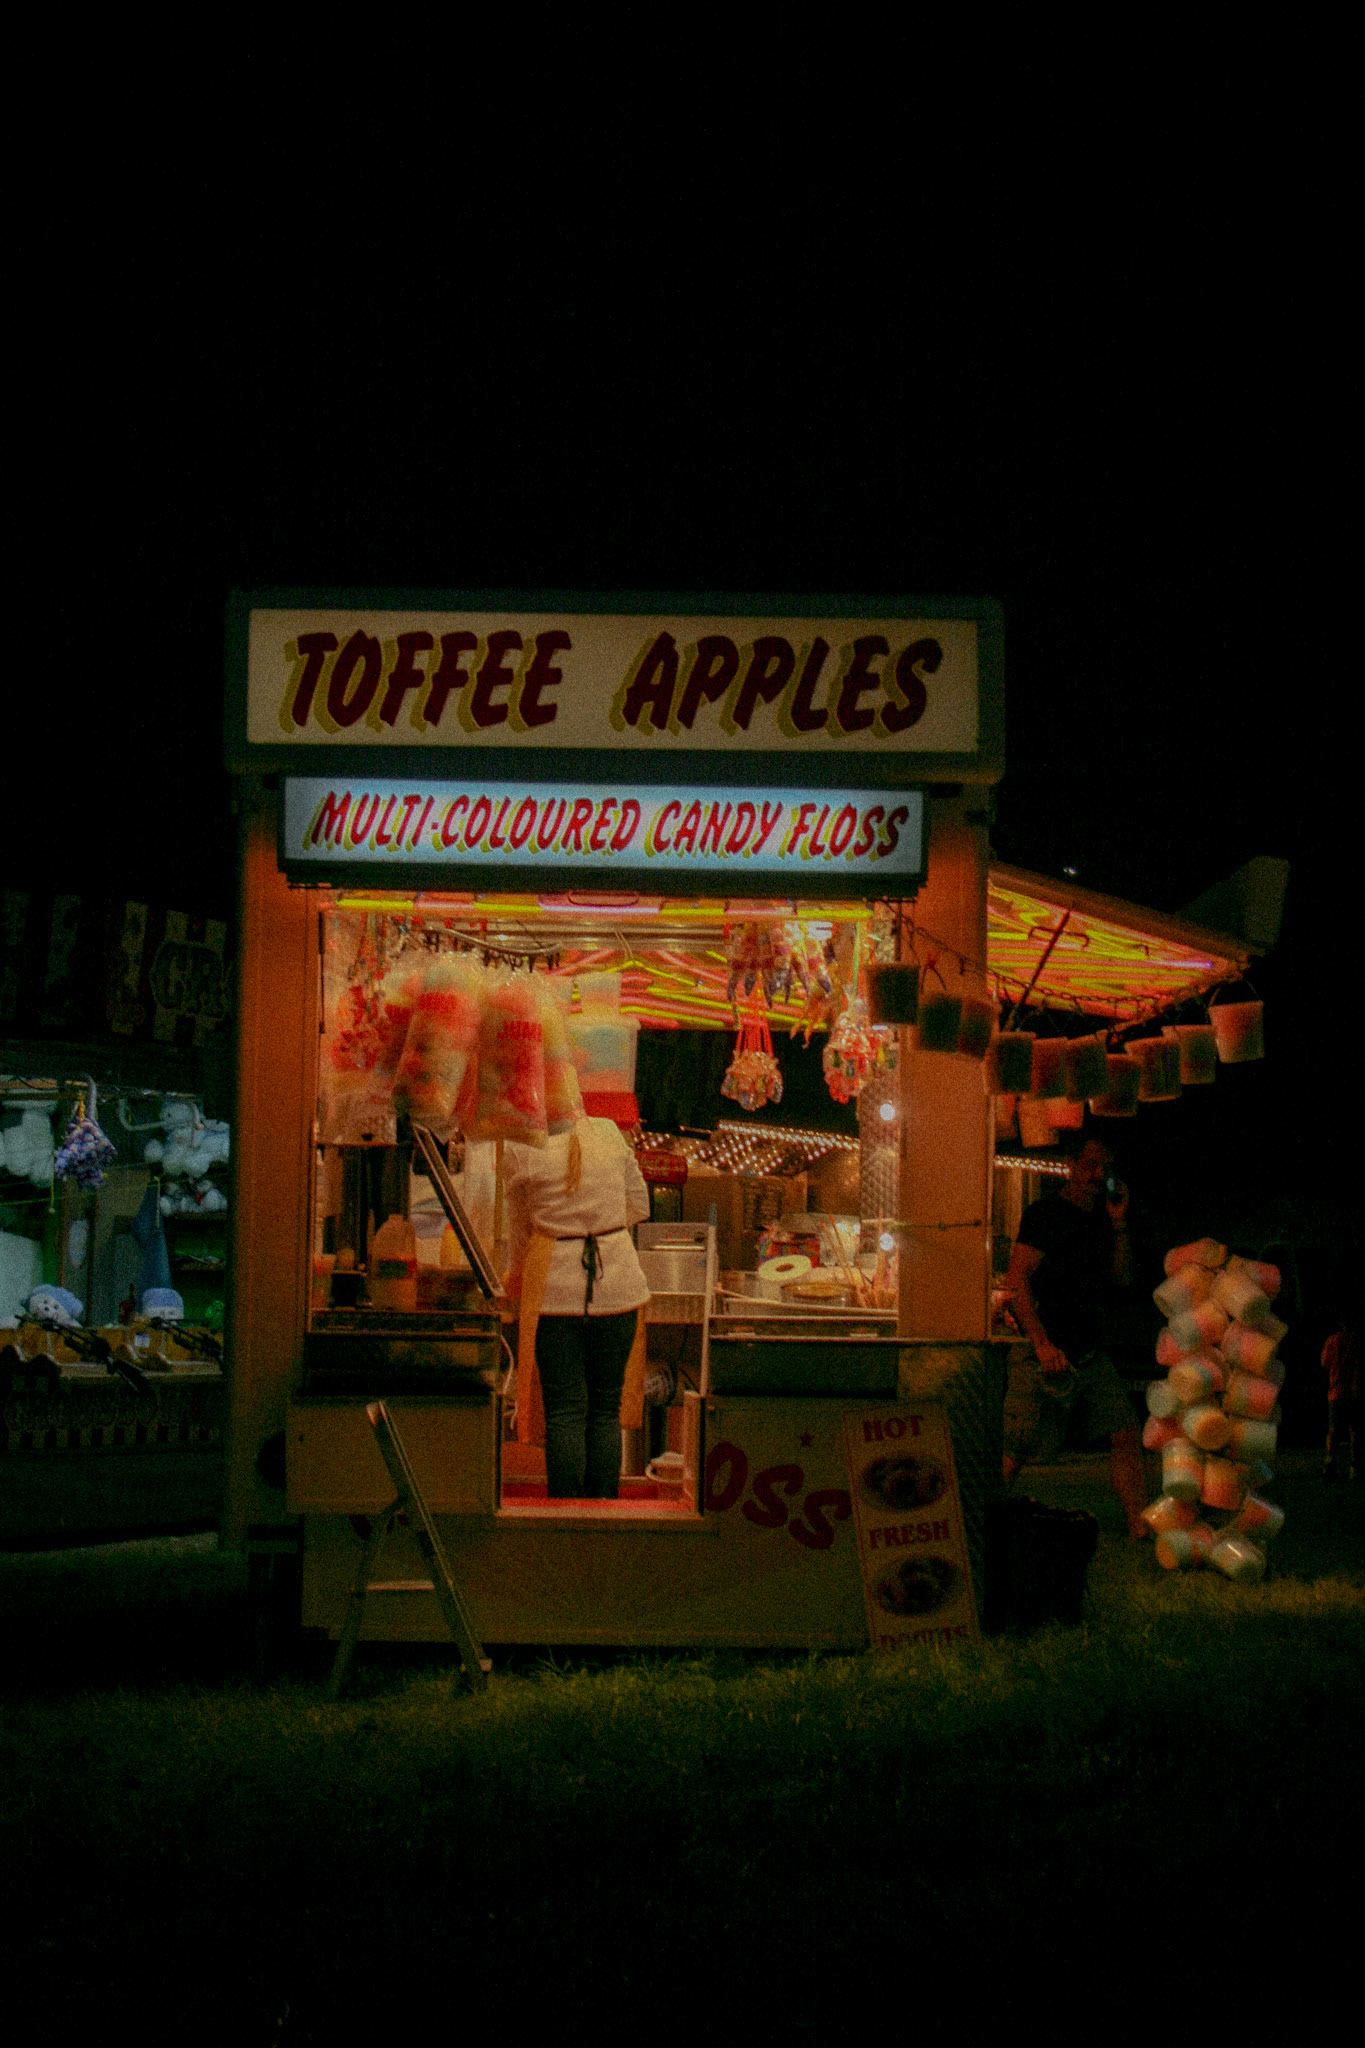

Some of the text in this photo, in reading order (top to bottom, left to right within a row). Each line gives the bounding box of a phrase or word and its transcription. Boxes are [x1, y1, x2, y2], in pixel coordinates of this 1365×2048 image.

[287, 630, 943, 735] TOFFEE APPLES
[307, 790, 910, 859] MULTI-COLOURED CANDY FLOSS
[862, 1414, 925, 1443] HOT
[869, 1519, 951, 1549] FRESH
